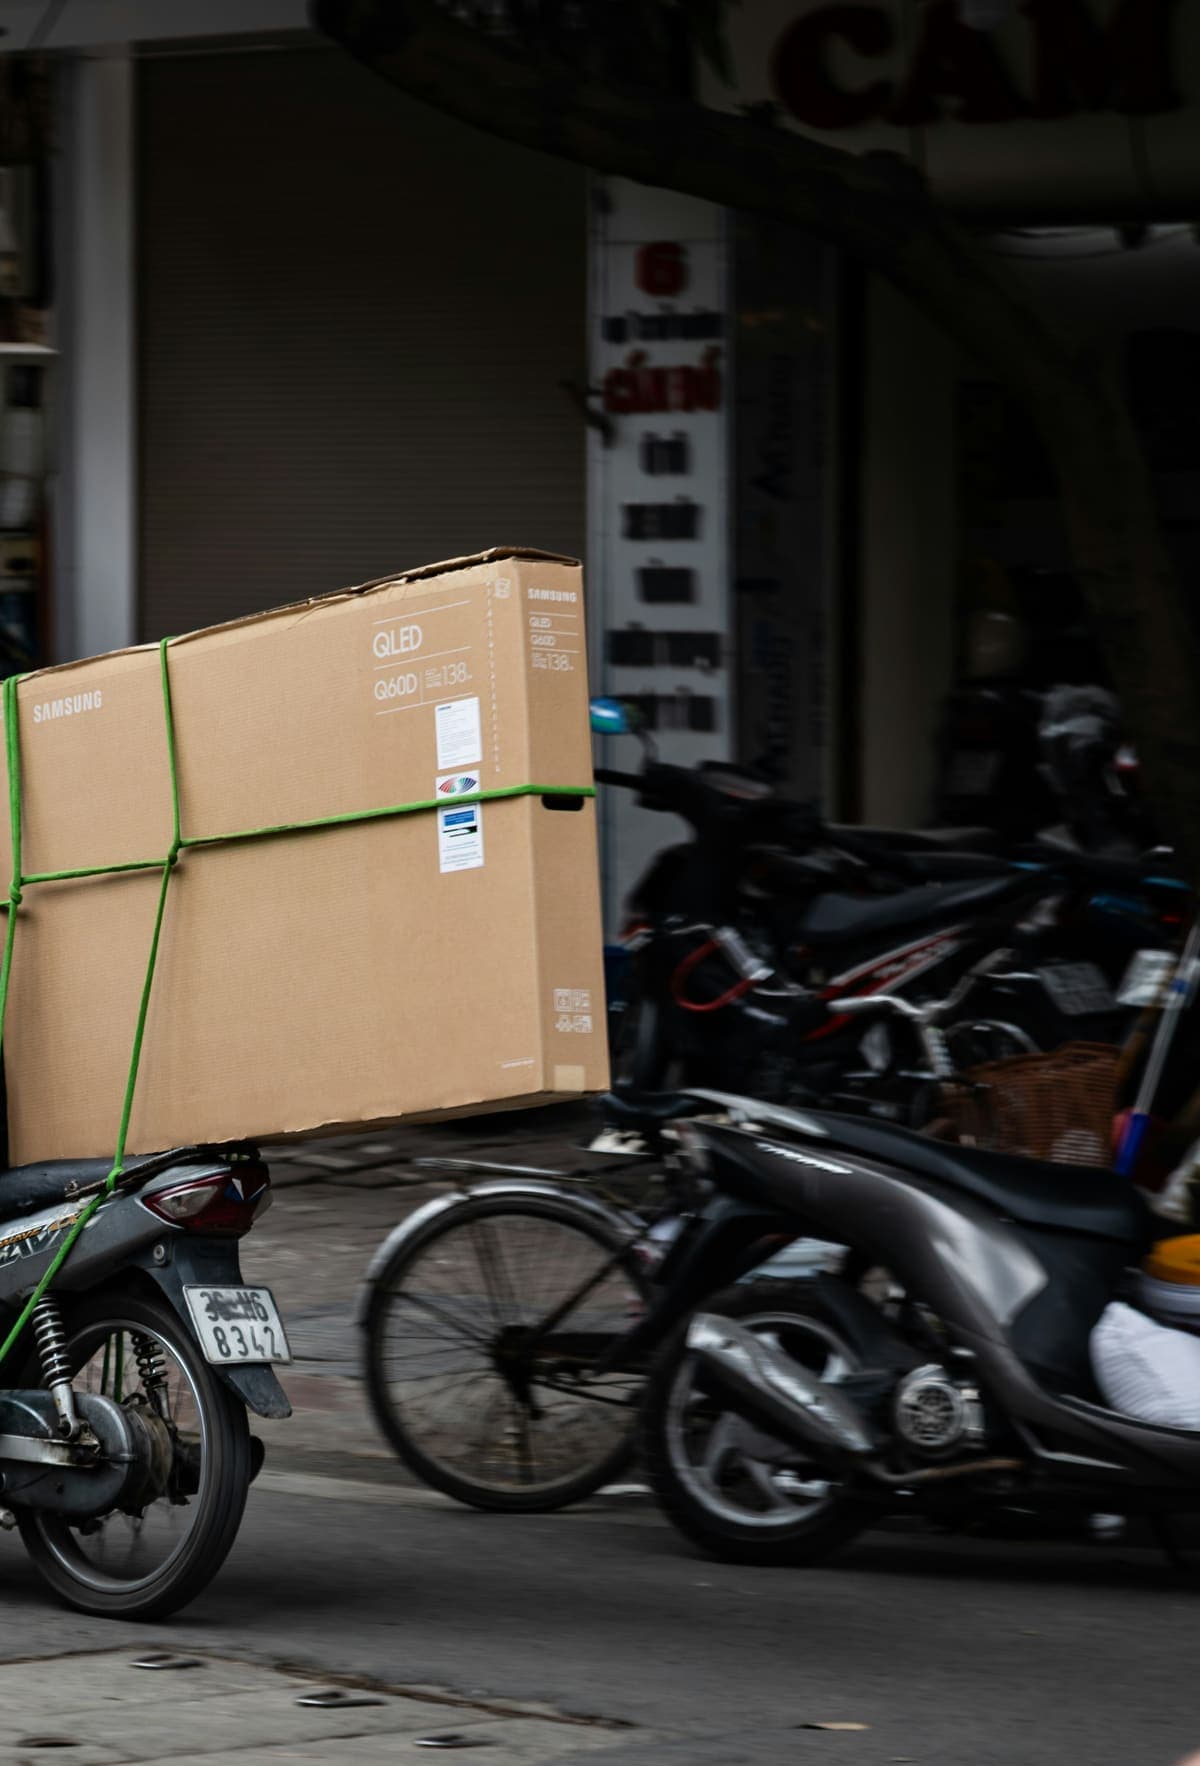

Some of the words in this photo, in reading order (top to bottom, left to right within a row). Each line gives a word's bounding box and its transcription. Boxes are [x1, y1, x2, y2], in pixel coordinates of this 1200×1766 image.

[527, 588, 577, 603] SAMSUNG
[529, 617, 552, 628] QLED
[372, 624, 423, 658] QLED
[374, 673, 418, 700] Q60D
[442, 661, 467, 686] 138
[33, 690, 103, 724] SAMSUNG
